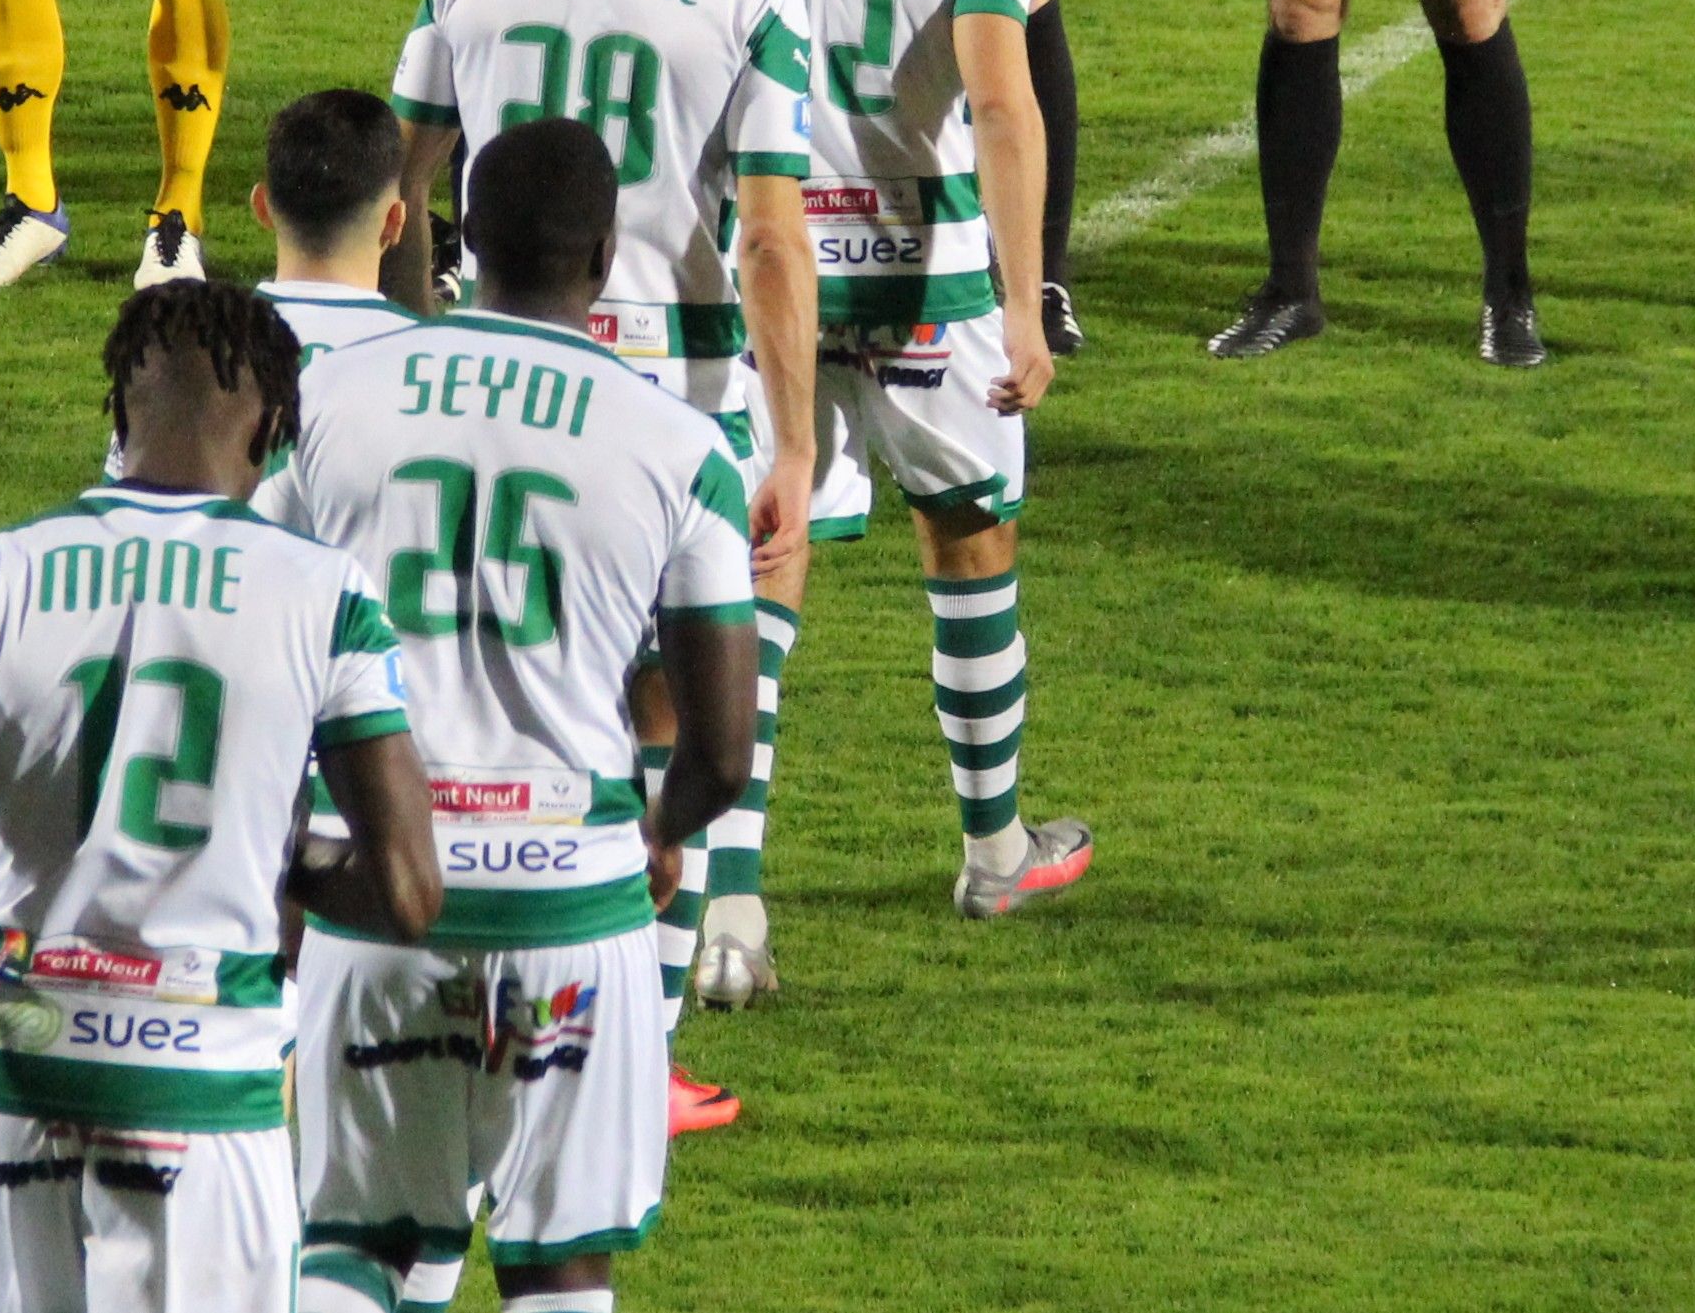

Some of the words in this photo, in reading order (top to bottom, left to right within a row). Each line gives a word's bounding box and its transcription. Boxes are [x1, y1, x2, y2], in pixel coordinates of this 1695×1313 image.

[496, 20, 664, 190] 28
[801, 193, 826, 209] ont
[828, 191, 872, 209] Neuf
[818, 237, 923, 265] suez
[397, 351, 595, 438] SEYDI
[383, 453, 581, 650] 25
[38, 535, 244, 615] MANE
[61, 653, 229, 852] 12
[465, 784, 522, 807] Neuf
[447, 839, 579, 873] suez
[93, 957, 153, 978] Neuf
[69, 1010, 201, 1053] suez
